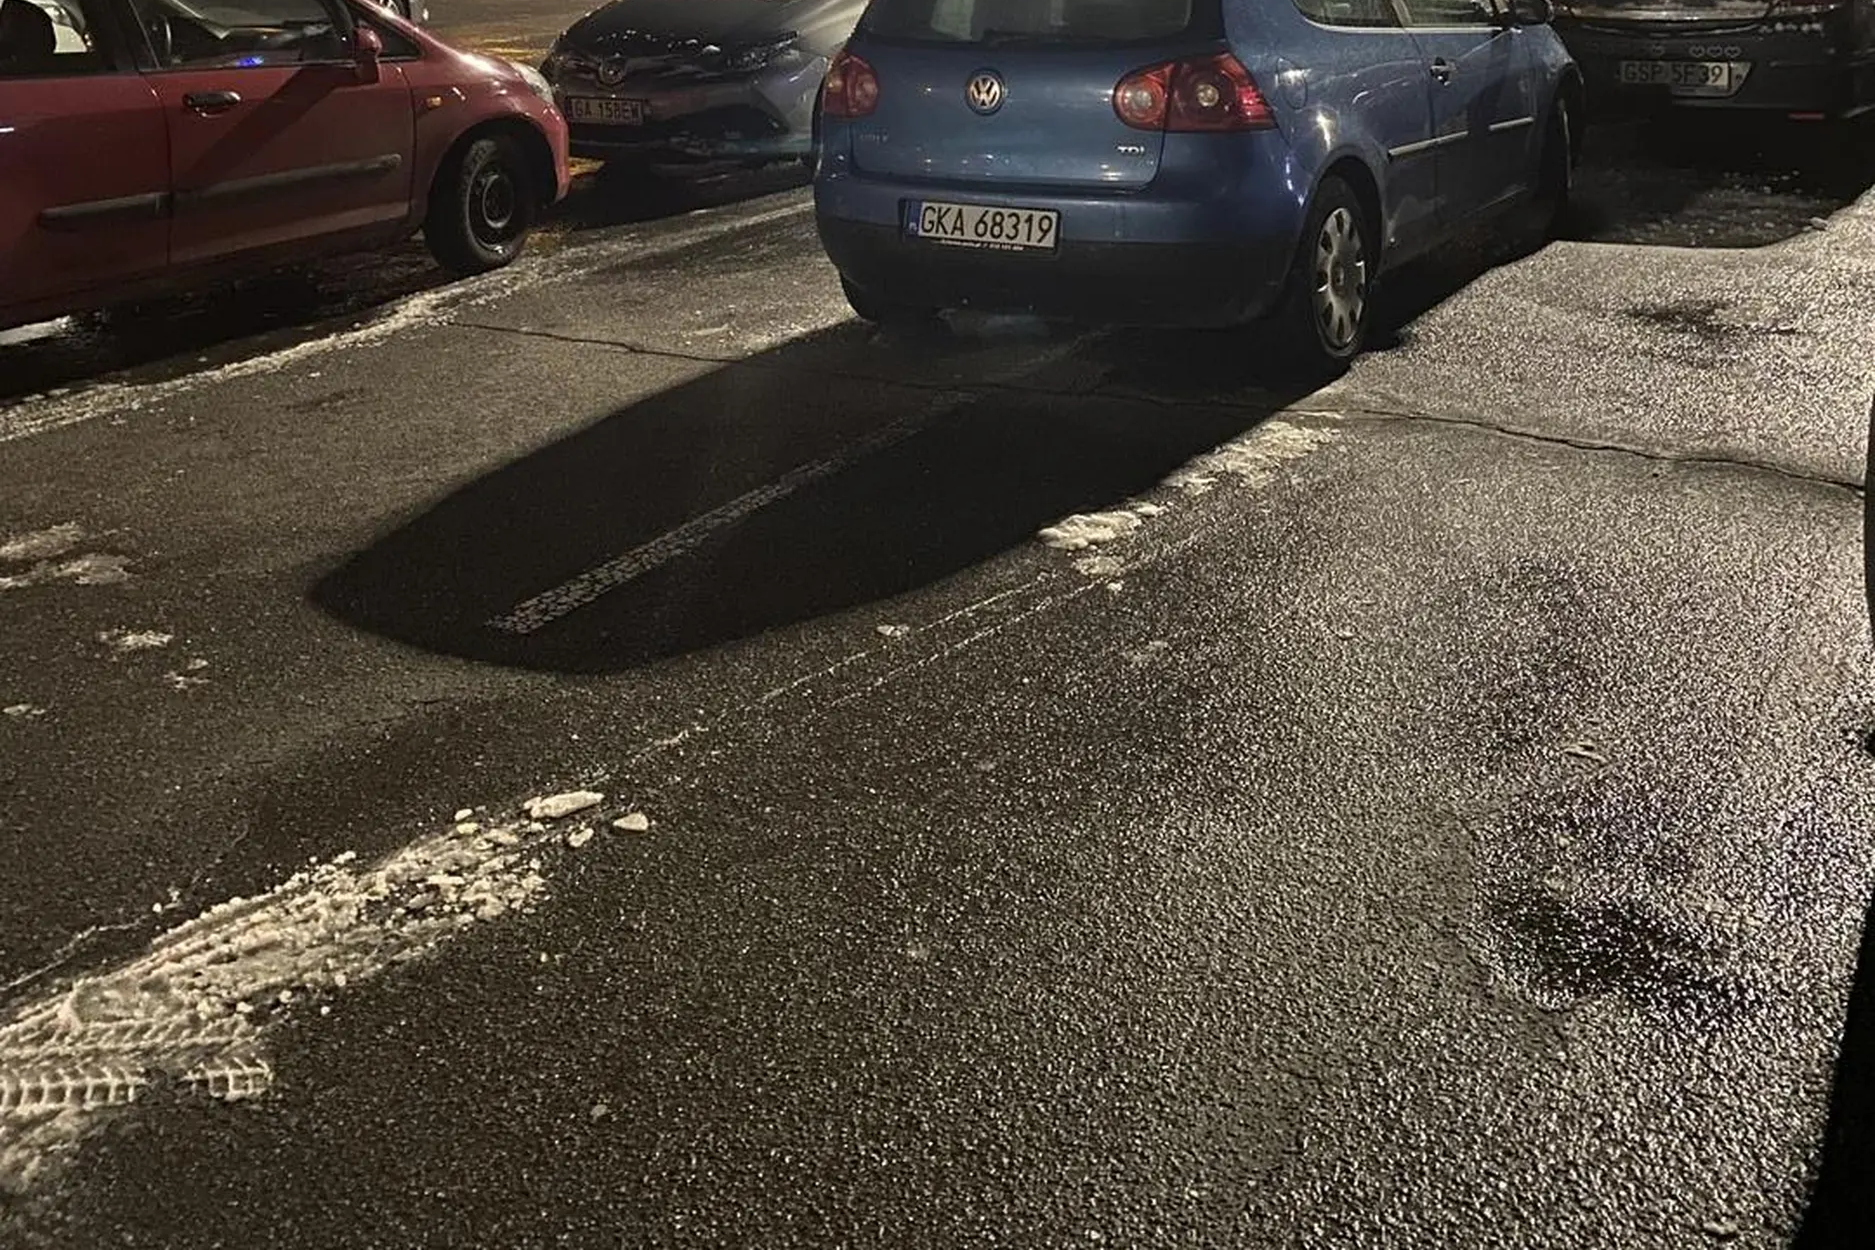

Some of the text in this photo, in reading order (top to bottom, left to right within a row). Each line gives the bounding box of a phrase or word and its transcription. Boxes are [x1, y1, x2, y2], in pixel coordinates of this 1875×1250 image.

[1624, 62, 1724, 84] GSP 5F39
[969, 75, 1000, 109] VW
[921, 206, 1054, 244] GKA 68319
